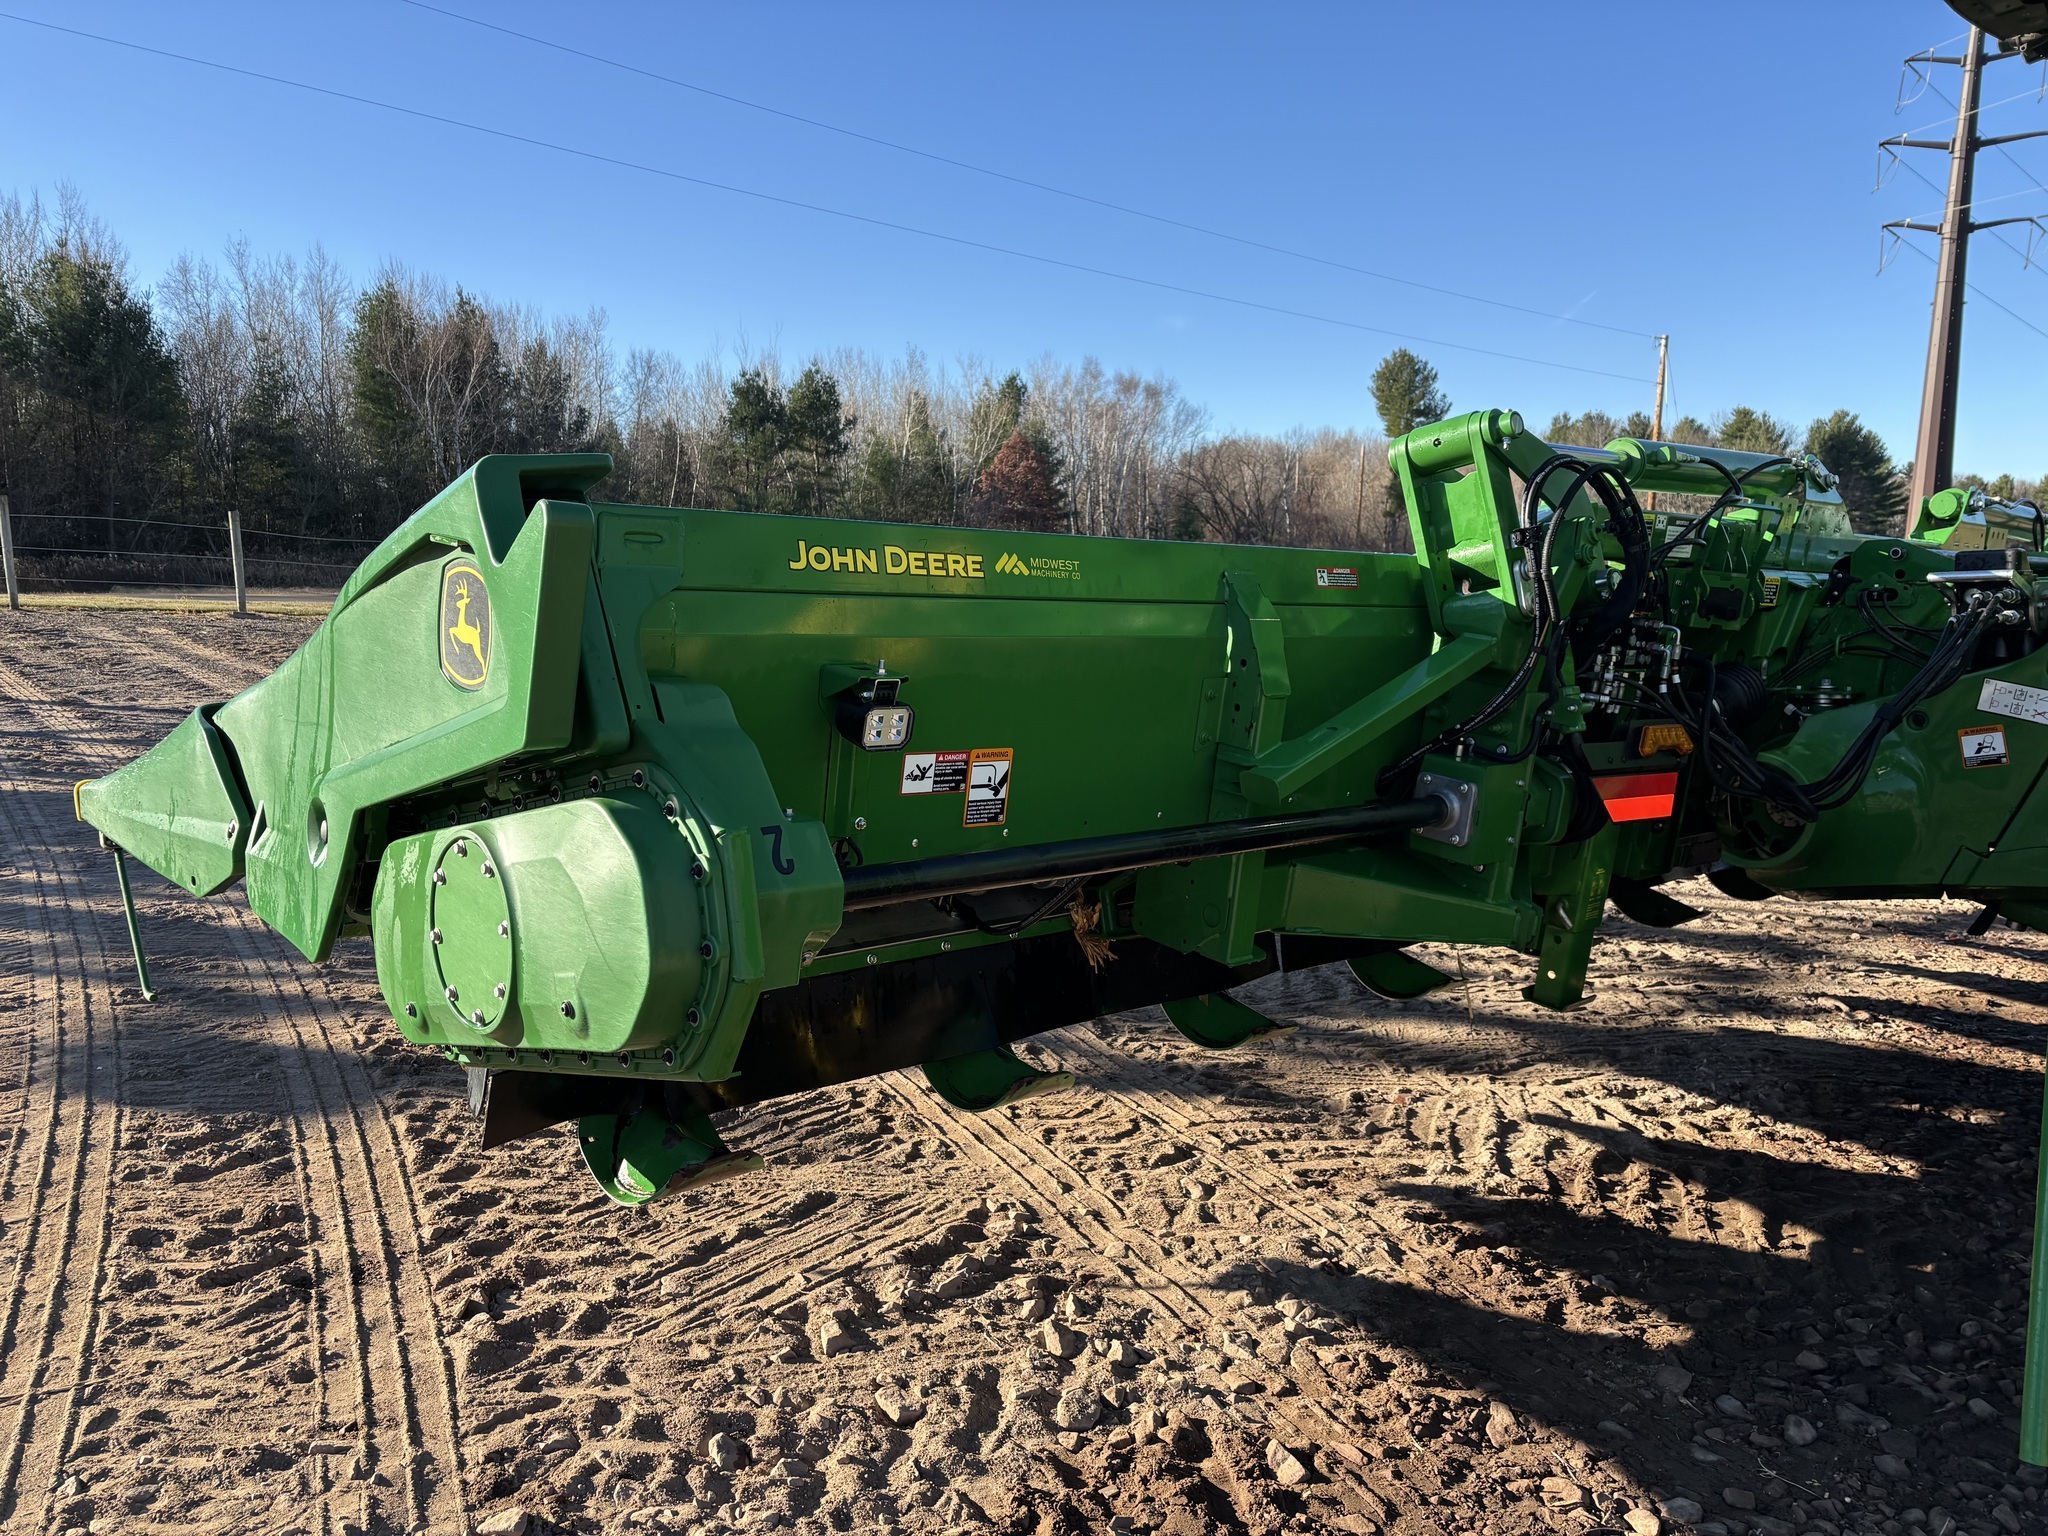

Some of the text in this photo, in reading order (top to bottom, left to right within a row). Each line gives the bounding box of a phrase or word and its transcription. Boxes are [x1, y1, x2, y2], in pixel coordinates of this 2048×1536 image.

[788, 540, 985, 579] JOHN DEERE
[1030, 557, 1080, 571] MIDWEST
[1031, 568, 1081, 580] MACHINERY CO
[1970, 726, 1998, 734] WARNING
[981, 751, 1009, 759] WARNING
